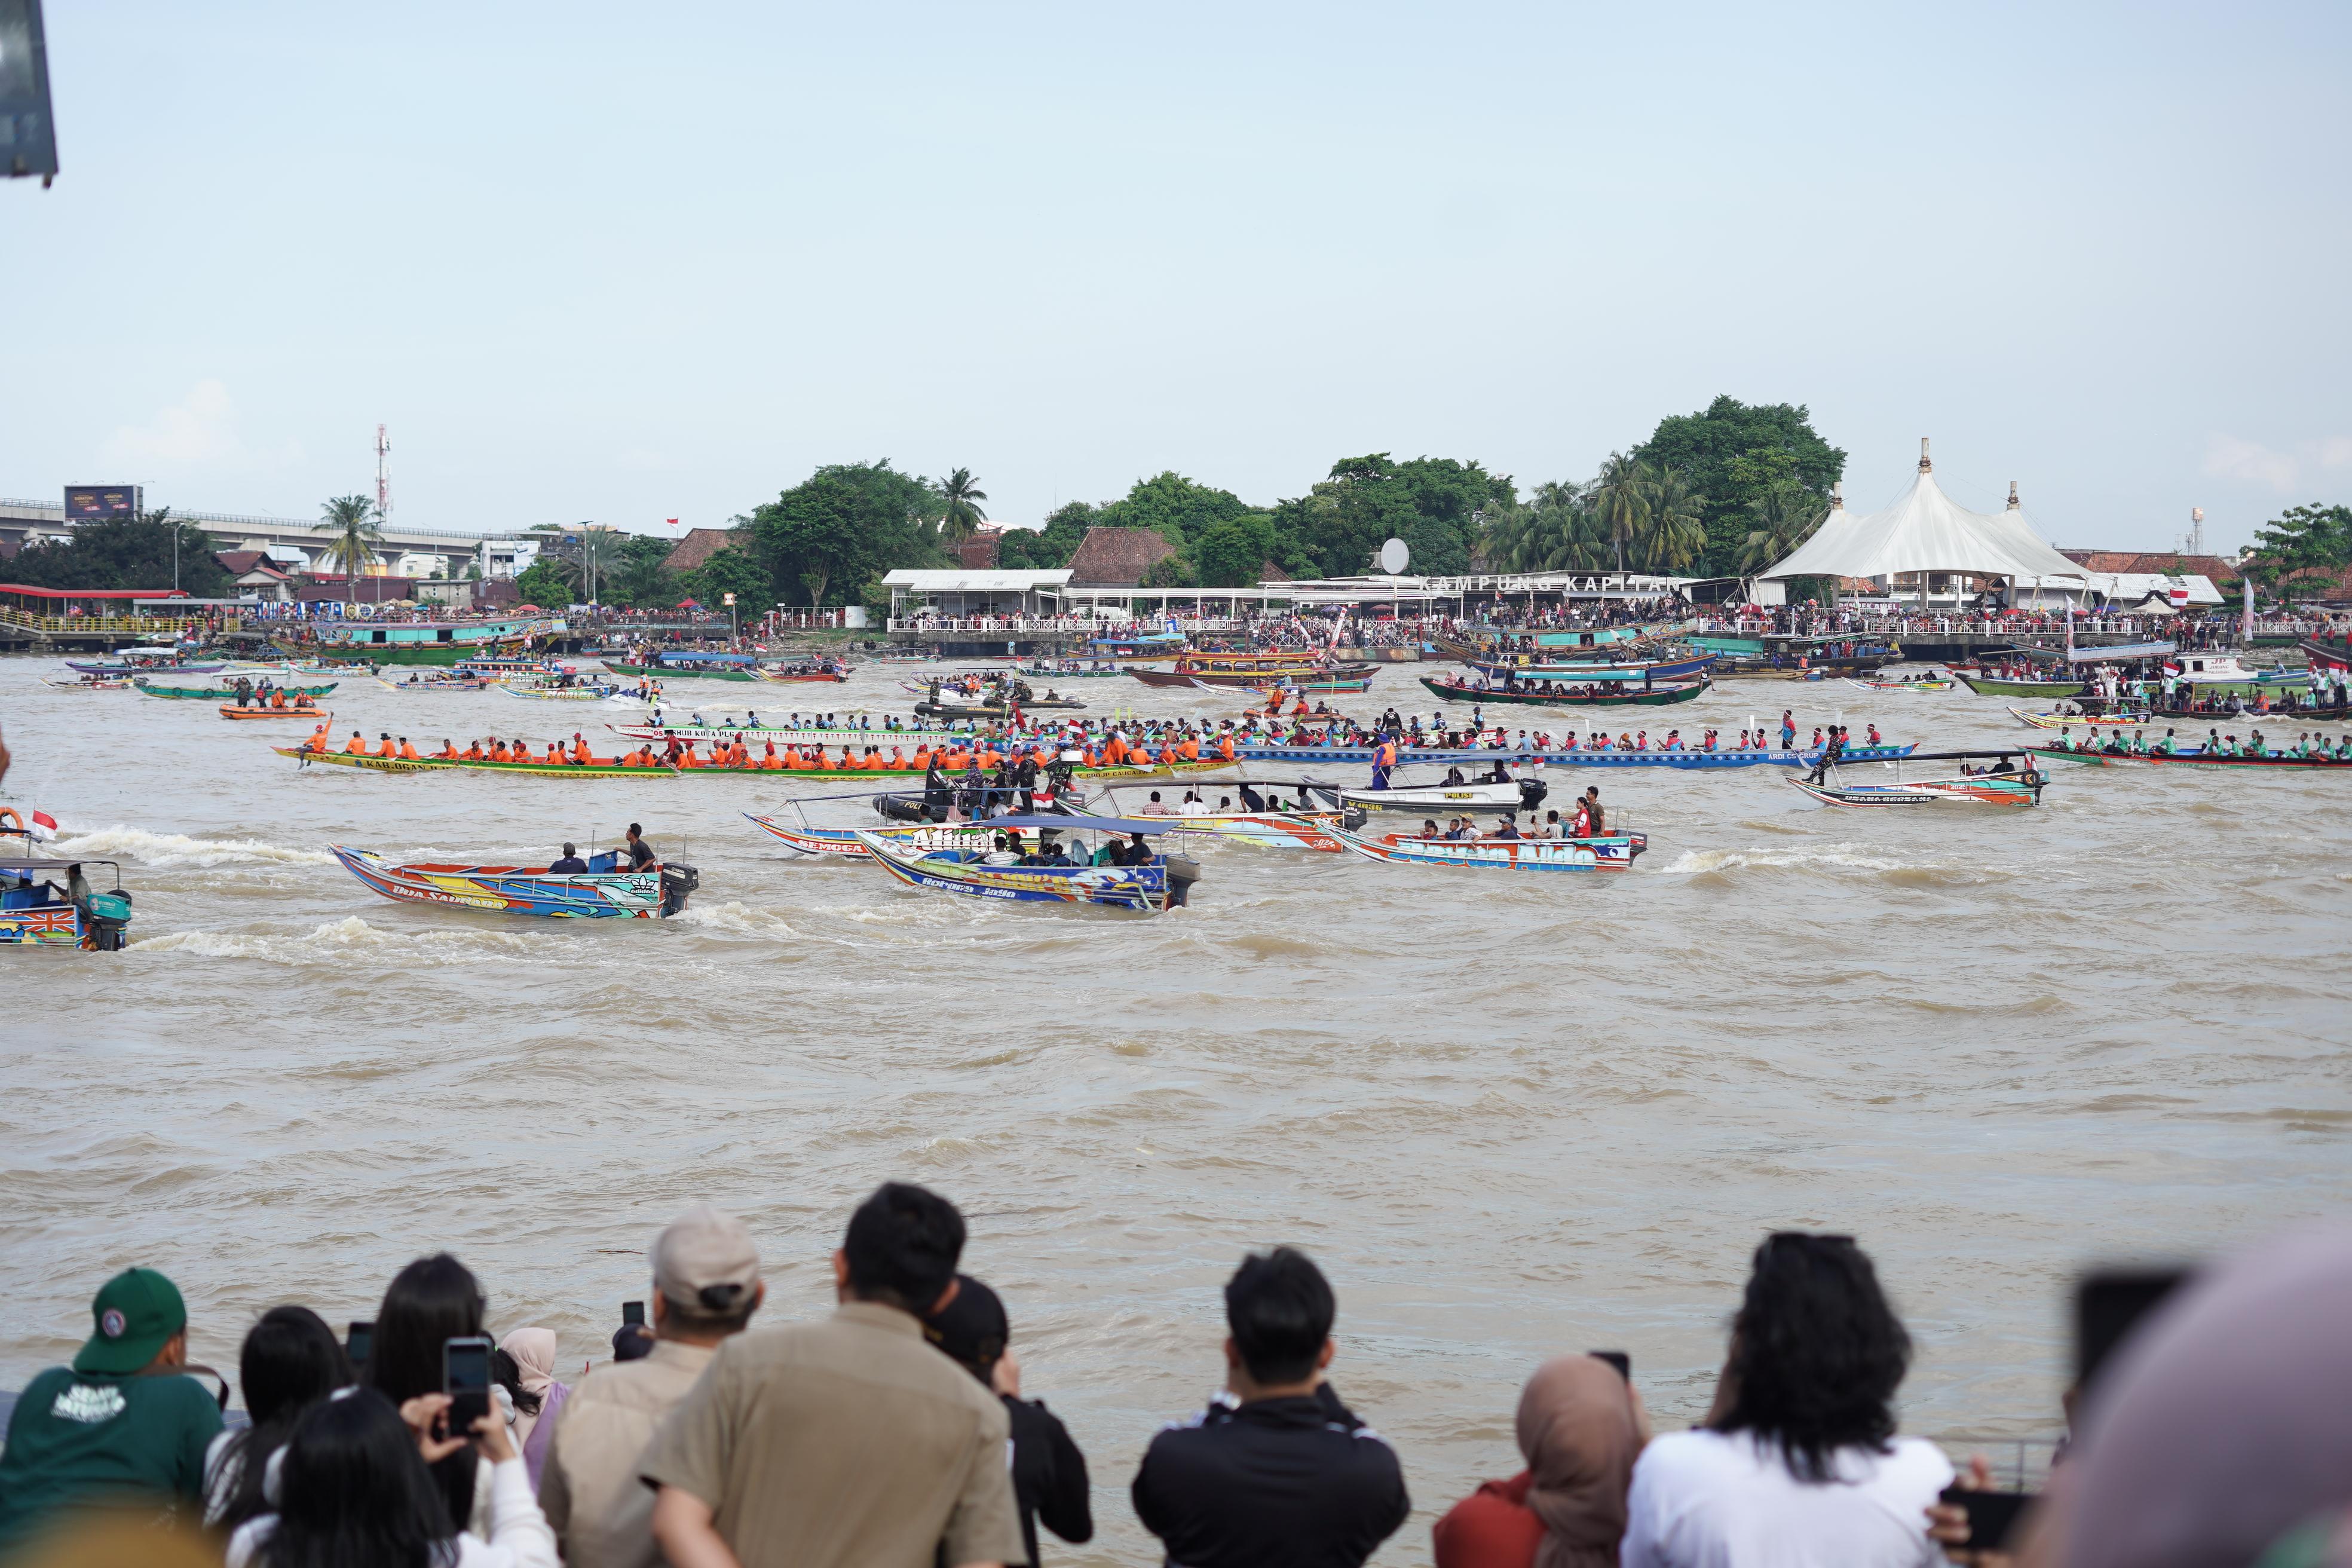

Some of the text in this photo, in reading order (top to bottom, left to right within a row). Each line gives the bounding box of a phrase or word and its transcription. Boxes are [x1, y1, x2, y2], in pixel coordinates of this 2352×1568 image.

[1419, 576, 1680, 592] KAMPUNG KAPITAN
[797, 840, 863, 852] SEMOGA
